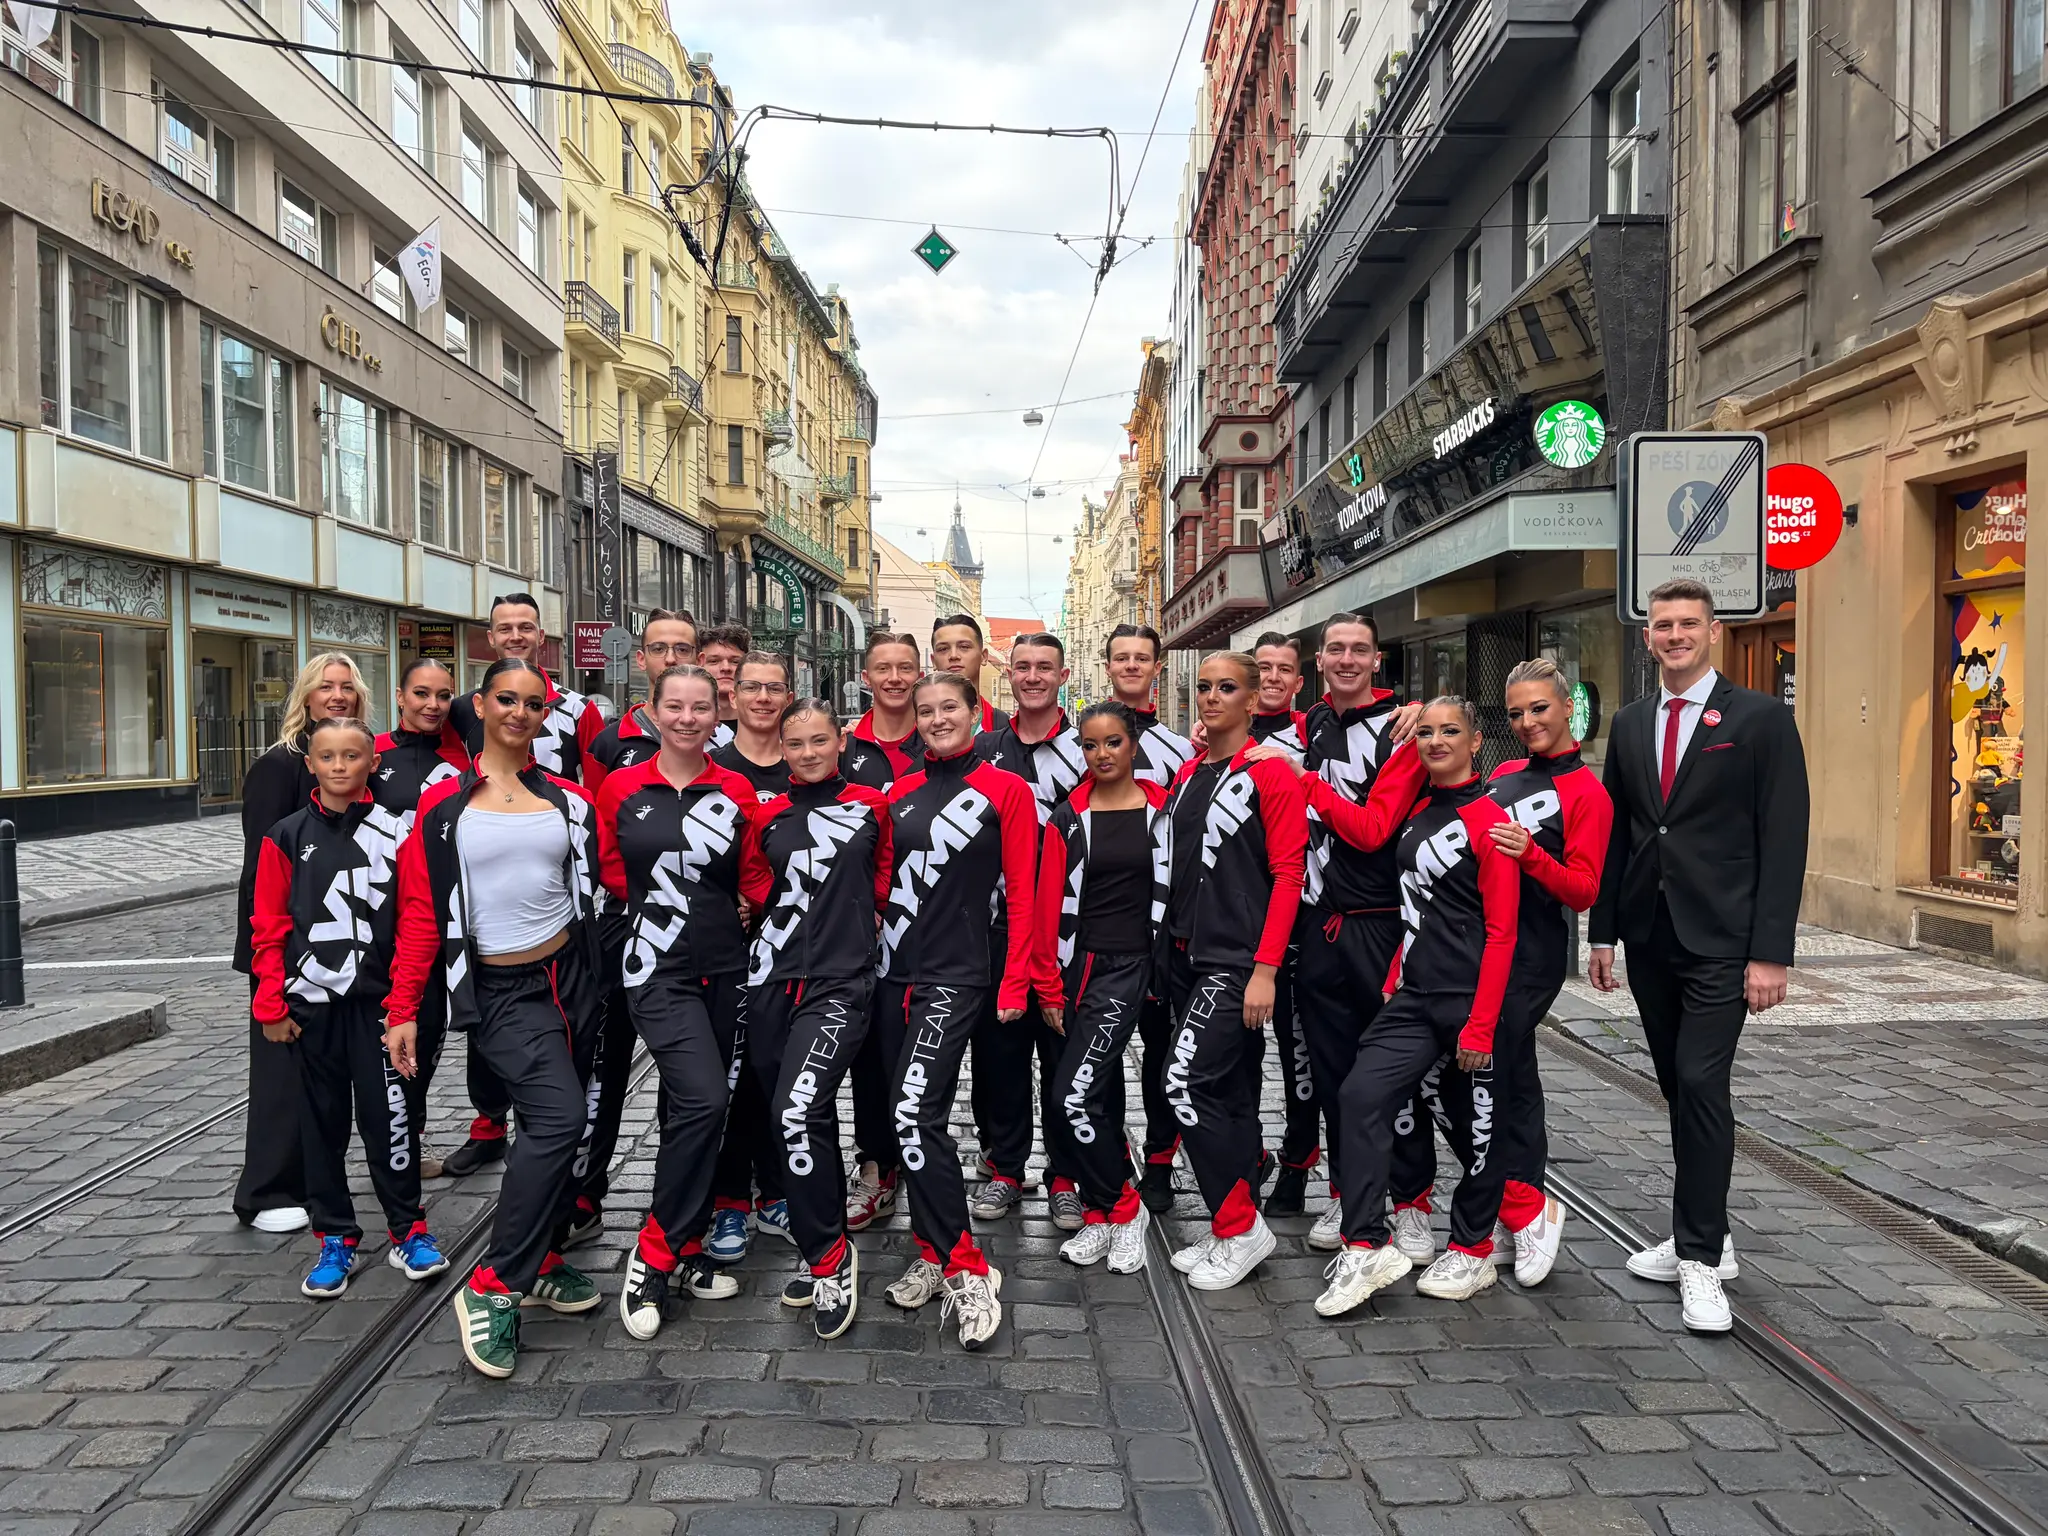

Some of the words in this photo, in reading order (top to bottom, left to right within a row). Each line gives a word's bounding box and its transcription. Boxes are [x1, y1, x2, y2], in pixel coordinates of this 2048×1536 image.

[321, 304, 363, 361] ČEB
[1432, 397, 1495, 460] STARBUCKS
[1348, 453, 1363, 487] 33
[1649, 450, 1690, 471] PĚŠÍ
[1696, 450, 1733, 471] ZÓN
[597, 458, 618, 538] FEAR
[1337, 482, 1386, 532] VODIČKOVA
[1557, 502, 1574, 514] 33
[1767, 495, 1814, 513] Hugo
[1523, 516, 1604, 527] VODIČKOVA
[1767, 510, 1817, 528] chodí
[1353, 527, 1381, 550] RESIDENCE
[600, 544, 614, 618] HOUSE
[759, 559, 776, 572] TEA
[776, 567, 785, 577] &
[783, 574, 802, 610] COFFEE
[578, 628, 607, 638] NAIL
[622, 790, 740, 988] OLYMP
